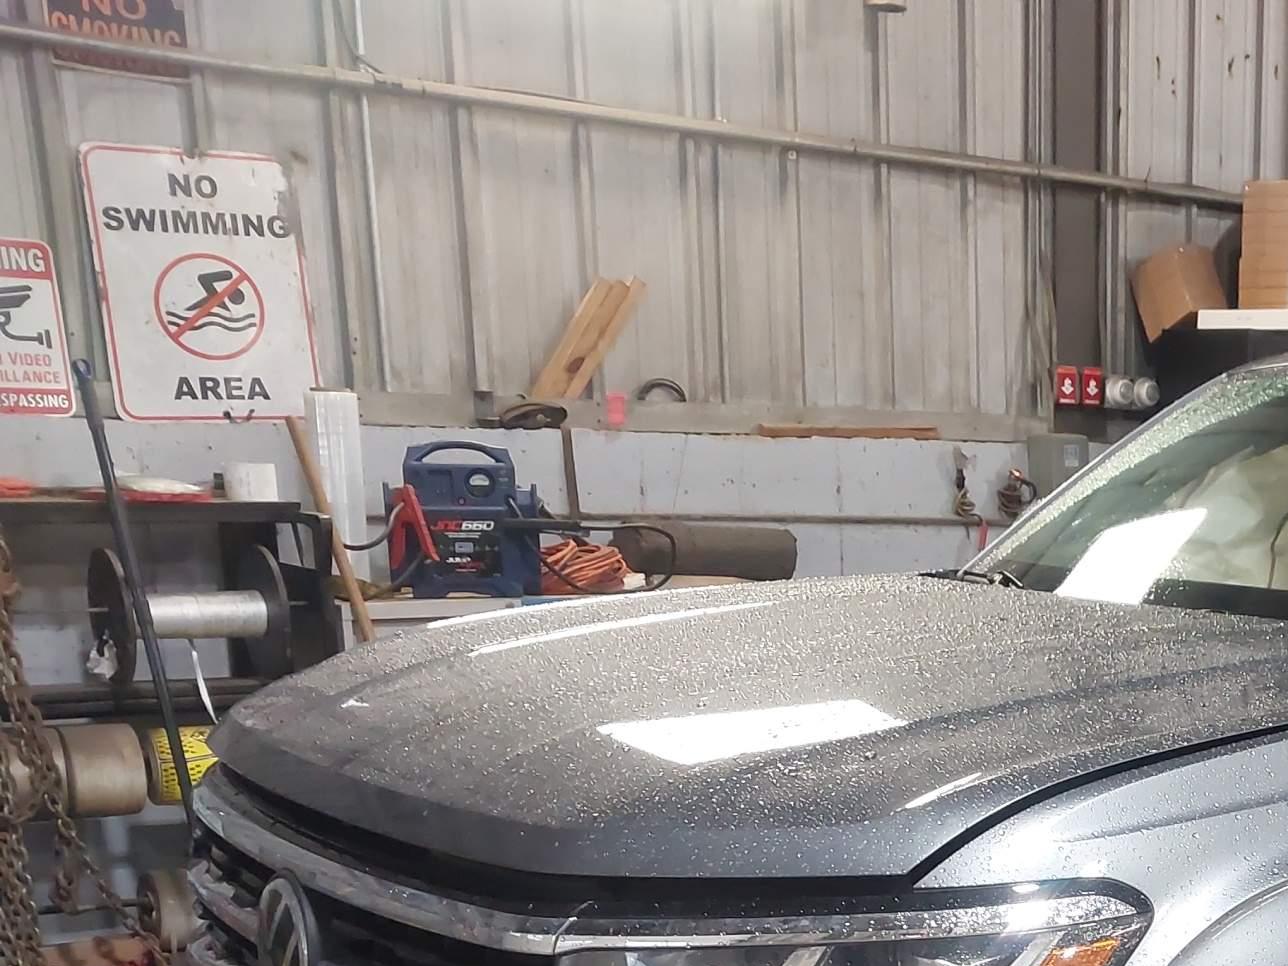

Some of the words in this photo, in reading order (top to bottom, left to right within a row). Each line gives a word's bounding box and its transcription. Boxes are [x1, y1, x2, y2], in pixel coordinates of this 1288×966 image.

[167, 173, 218, 199] NO
[102, 207, 289, 238] SWIMMING
[8, 353, 53, 367] VIDEO
[174, 376, 272, 400] AREA
[0, 393, 70, 409] SPASSING
